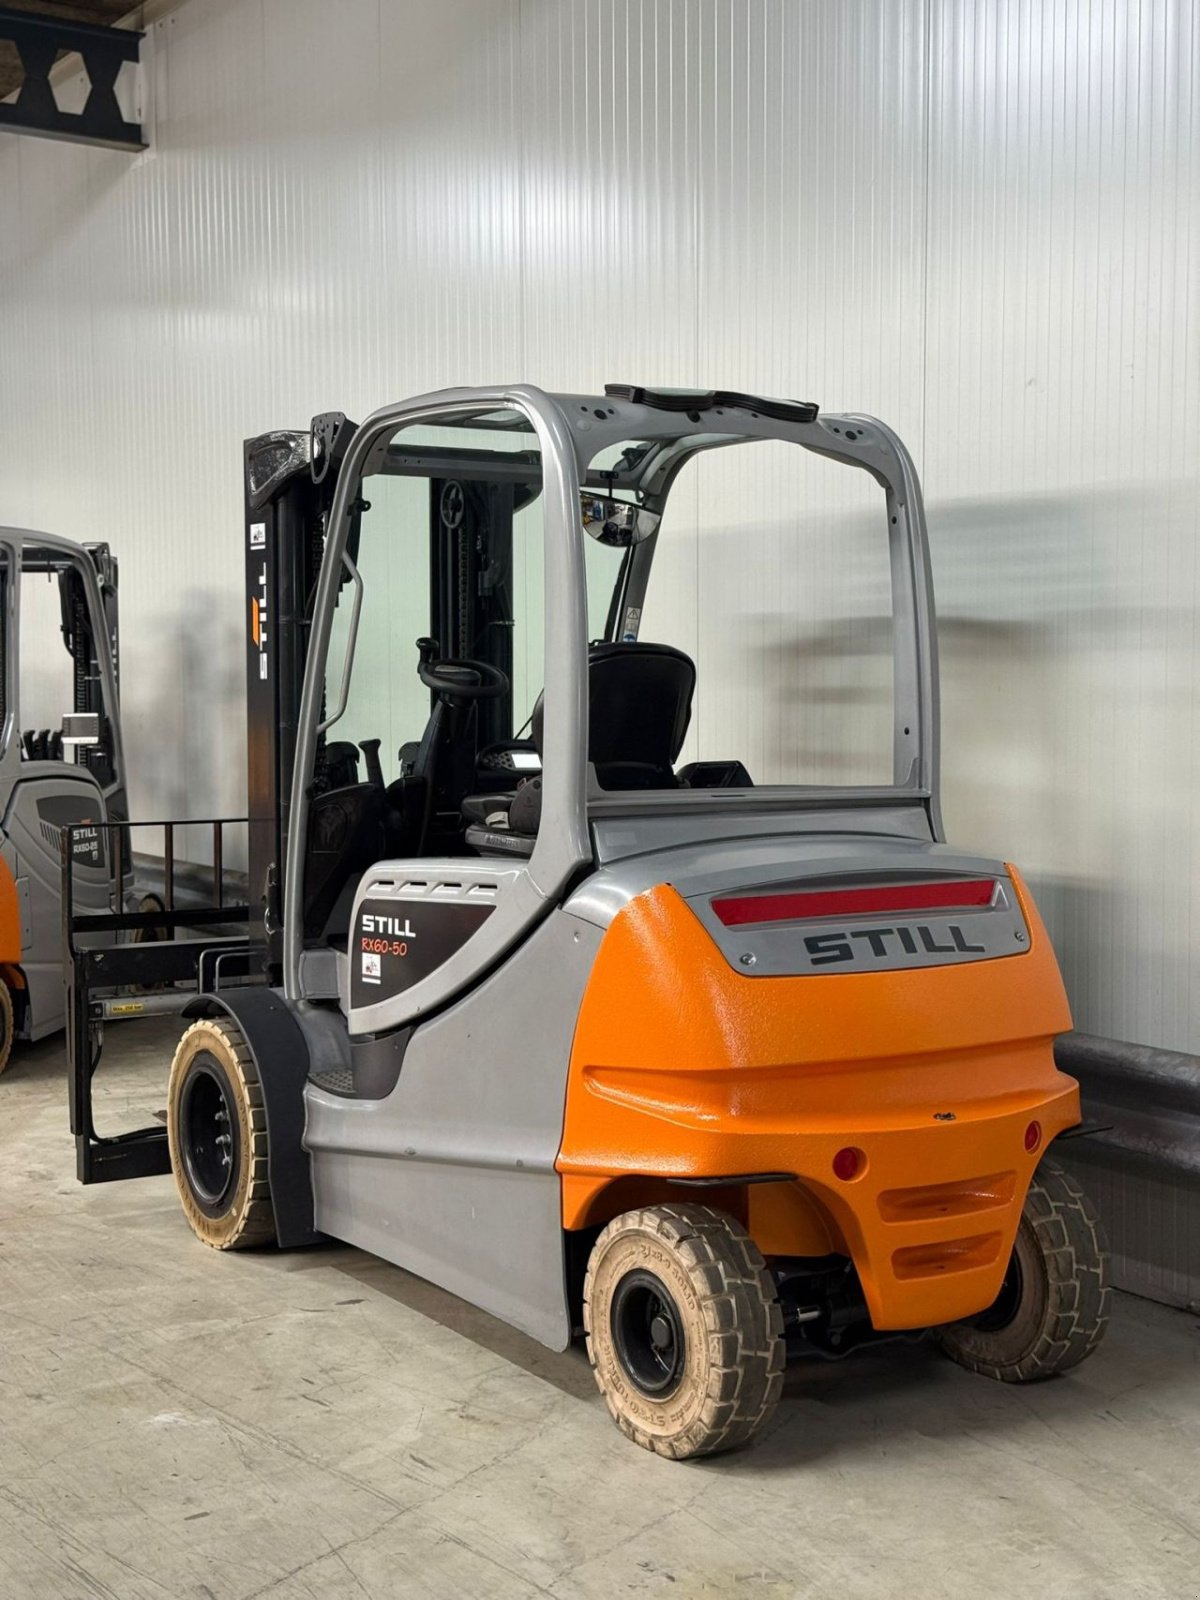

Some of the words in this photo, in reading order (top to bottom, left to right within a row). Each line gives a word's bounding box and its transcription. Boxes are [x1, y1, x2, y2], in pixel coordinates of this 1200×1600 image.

[259, 562, 267, 679] STILL
[73, 826, 98, 840] STILL
[362, 914, 416, 938] STILL
[361, 937, 407, 956] RX60-50
[803, 926, 986, 965] STILL
